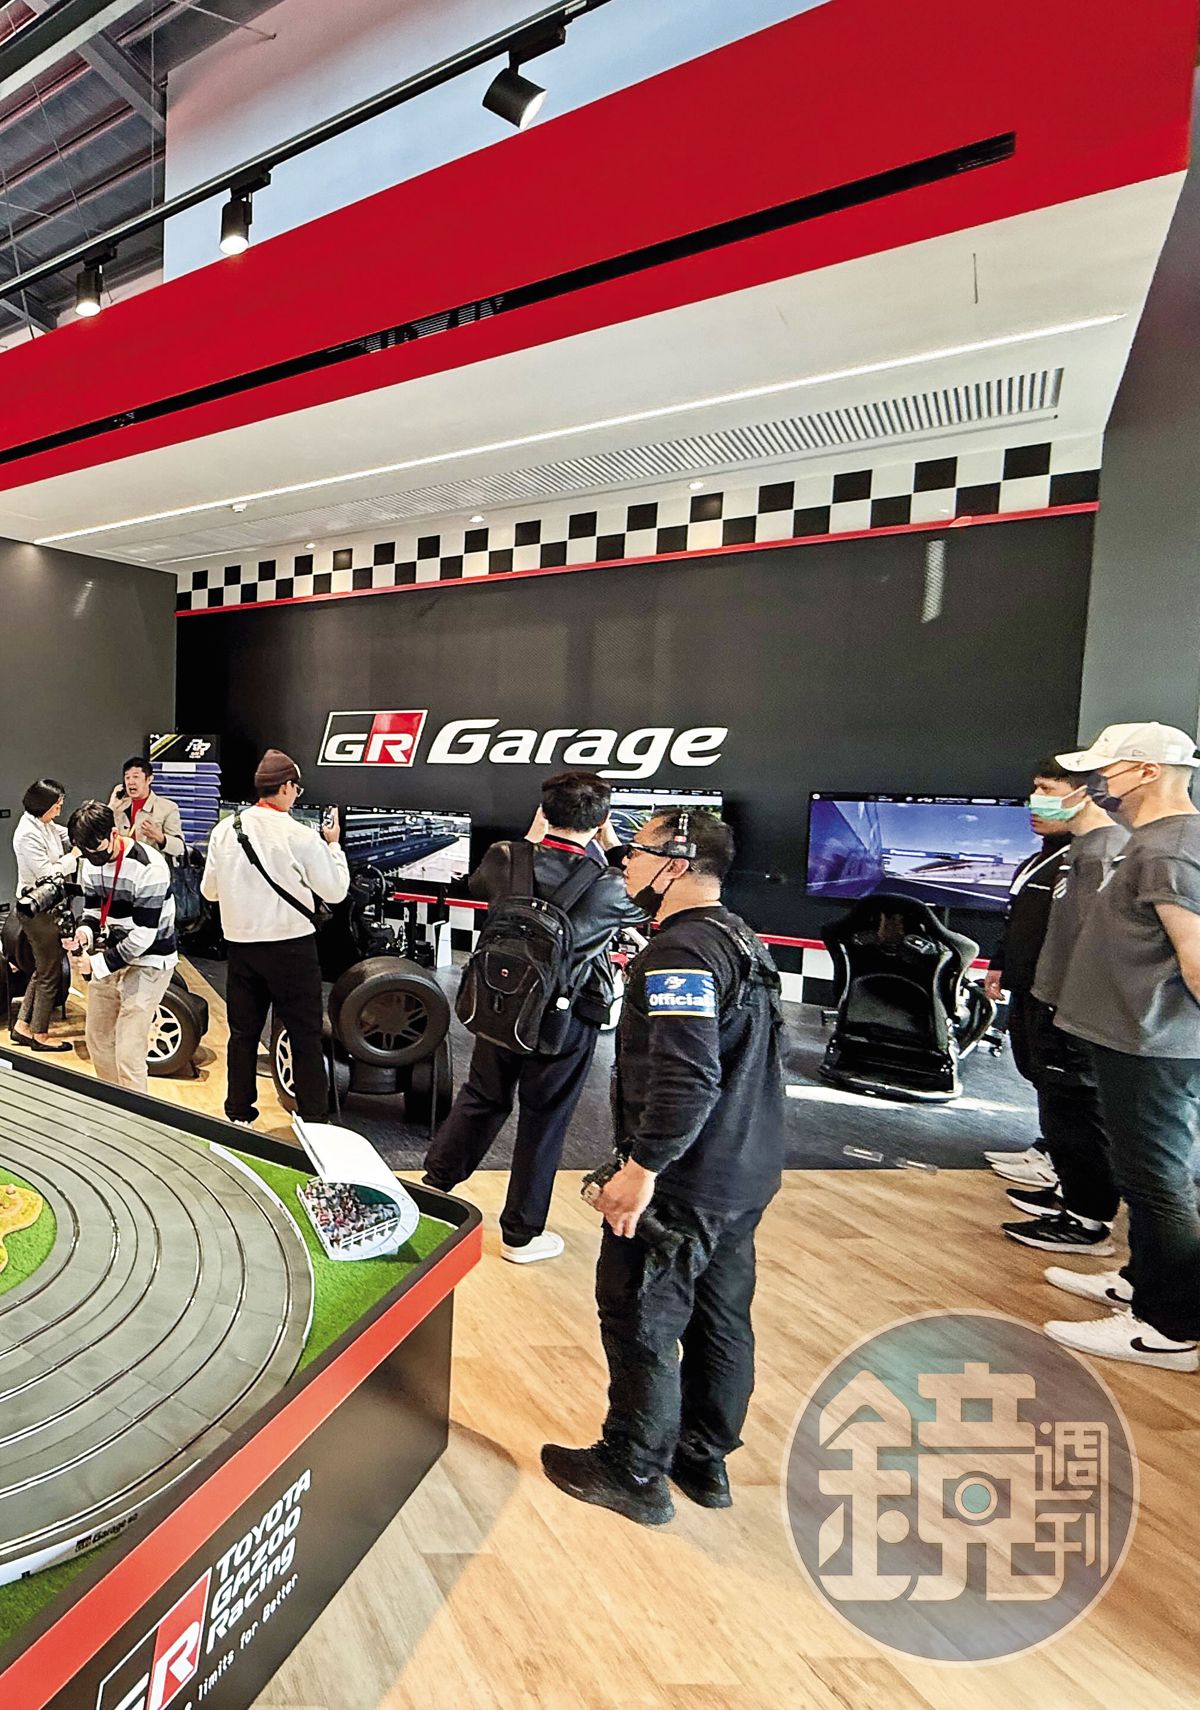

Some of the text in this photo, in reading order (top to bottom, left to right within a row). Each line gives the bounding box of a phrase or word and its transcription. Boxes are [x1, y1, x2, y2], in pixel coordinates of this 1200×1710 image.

[324, 718, 729, 779] GR Garage
[649, 992, 708, 1006] Official
[211, 1506, 301, 1620] GAZOO
[216, 1468, 312, 1584] TOYOTA
[199, 1574, 298, 1701] limits for Better
[206, 1537, 296, 1654] Racing
